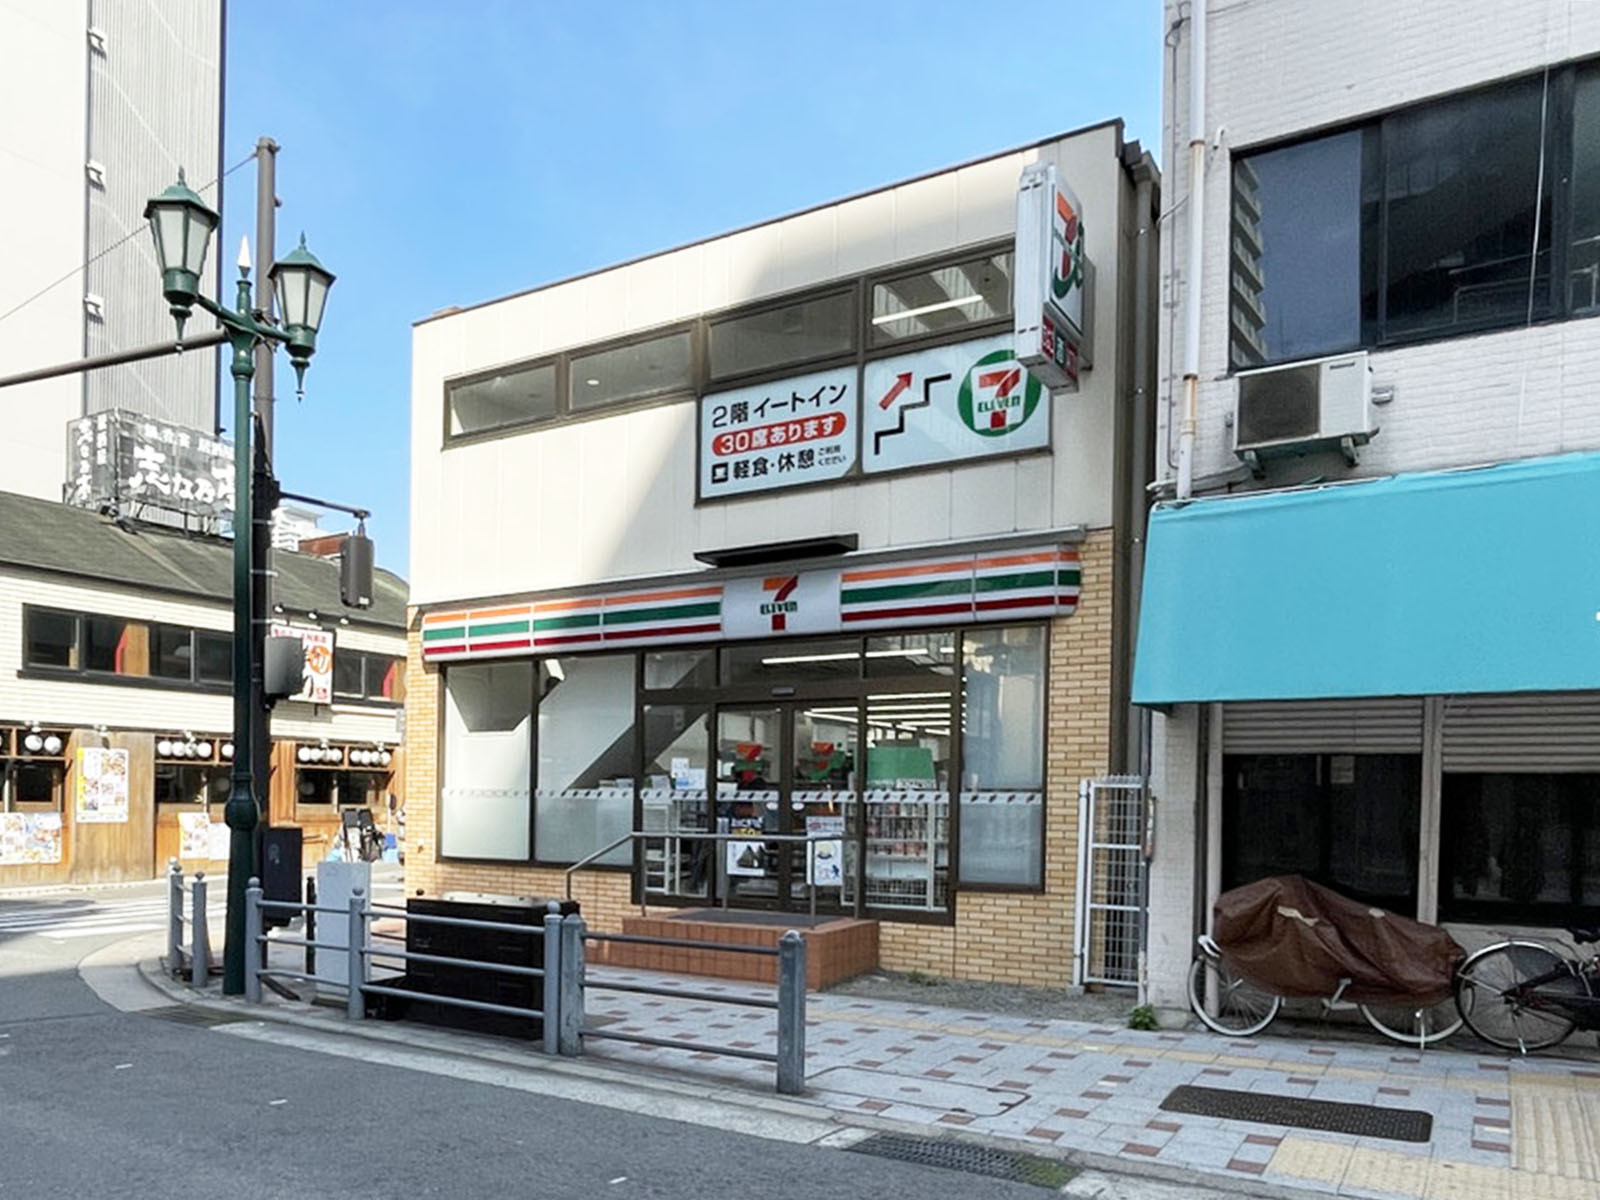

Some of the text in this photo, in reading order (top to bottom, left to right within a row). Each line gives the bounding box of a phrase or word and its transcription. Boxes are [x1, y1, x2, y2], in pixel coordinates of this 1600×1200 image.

[720, 416, 838, 454] 30席あります
